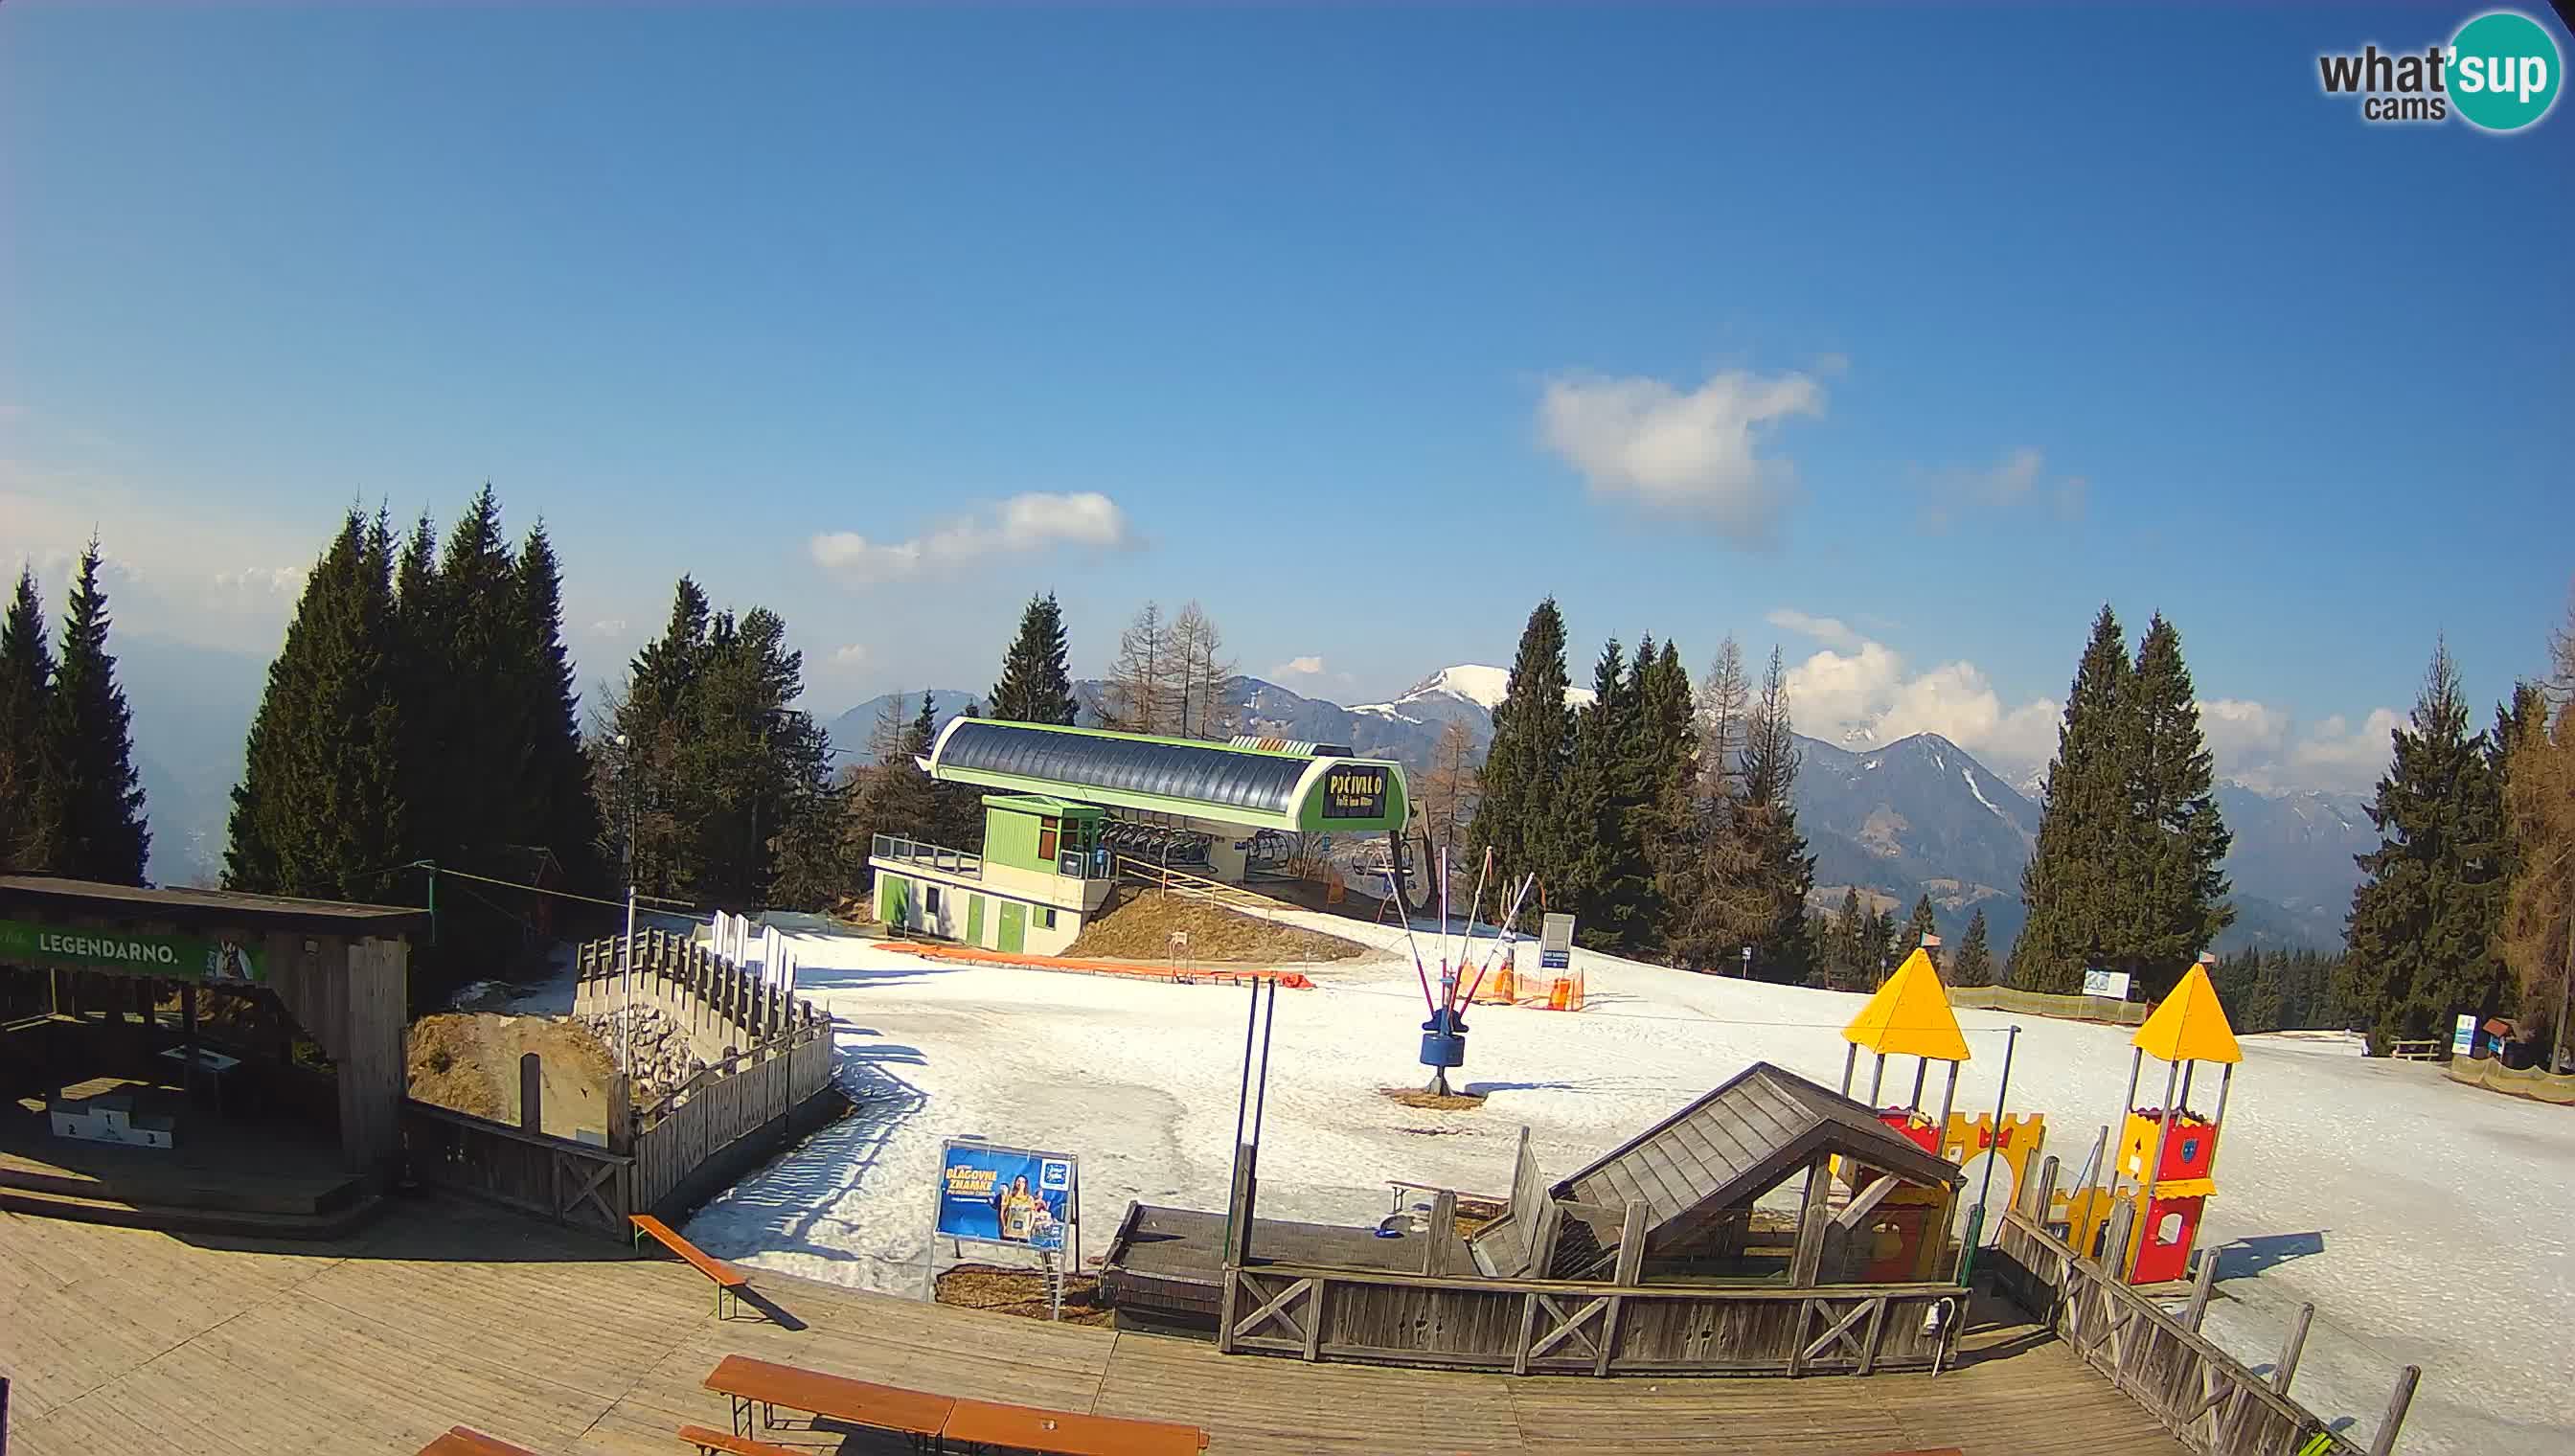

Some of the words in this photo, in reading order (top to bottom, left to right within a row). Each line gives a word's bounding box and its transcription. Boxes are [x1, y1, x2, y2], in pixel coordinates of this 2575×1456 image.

[39, 933, 179, 964] LEGENDARNO.
[106, 1113, 112, 1125] 1
[68, 1124, 76, 1135] 2
[147, 1132, 156, 1144] 3
[948, 1179, 992, 1191] ZNAMKE
